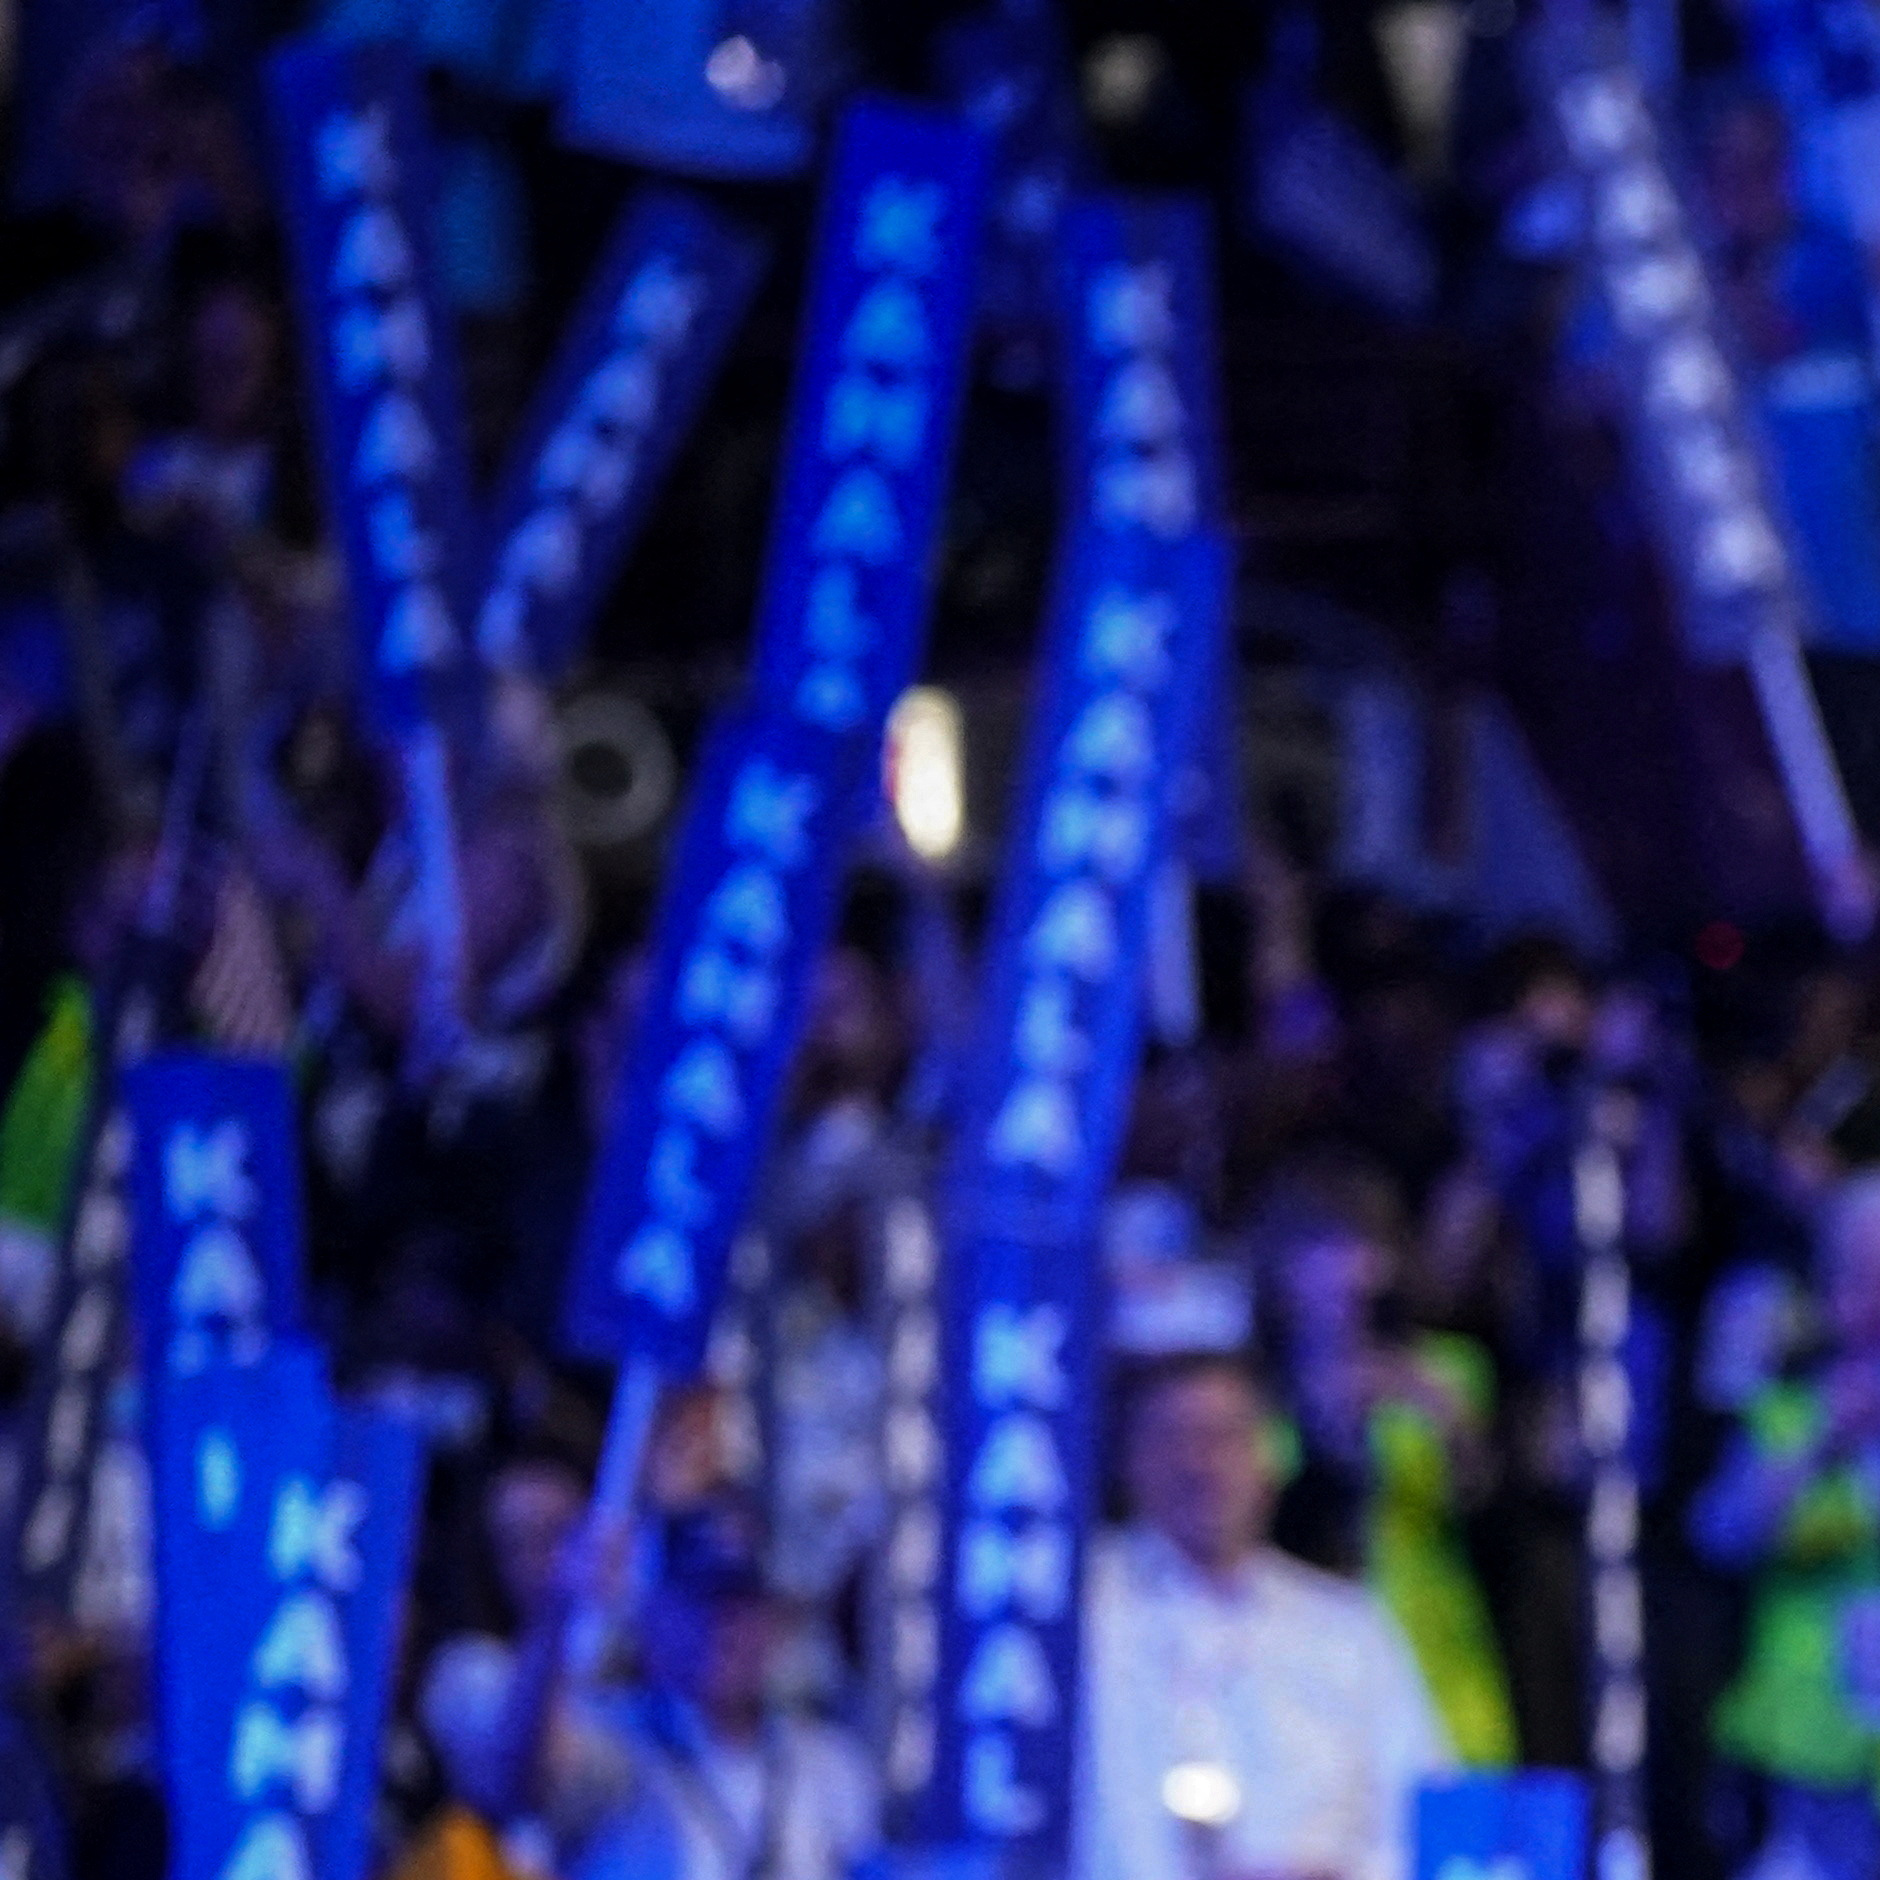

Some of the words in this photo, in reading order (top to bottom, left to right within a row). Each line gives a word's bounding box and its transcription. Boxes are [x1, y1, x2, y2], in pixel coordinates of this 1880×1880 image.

[312, 105, 460, 677] KAMALA
[476, 250, 708, 675] KAMAL
[1088, 265, 1200, 540] KAM
[616, 752, 818, 1320] KAMALA
[998, 590, 1180, 1182] KAMALA
[958, 1298, 1078, 1838] KAMAL
